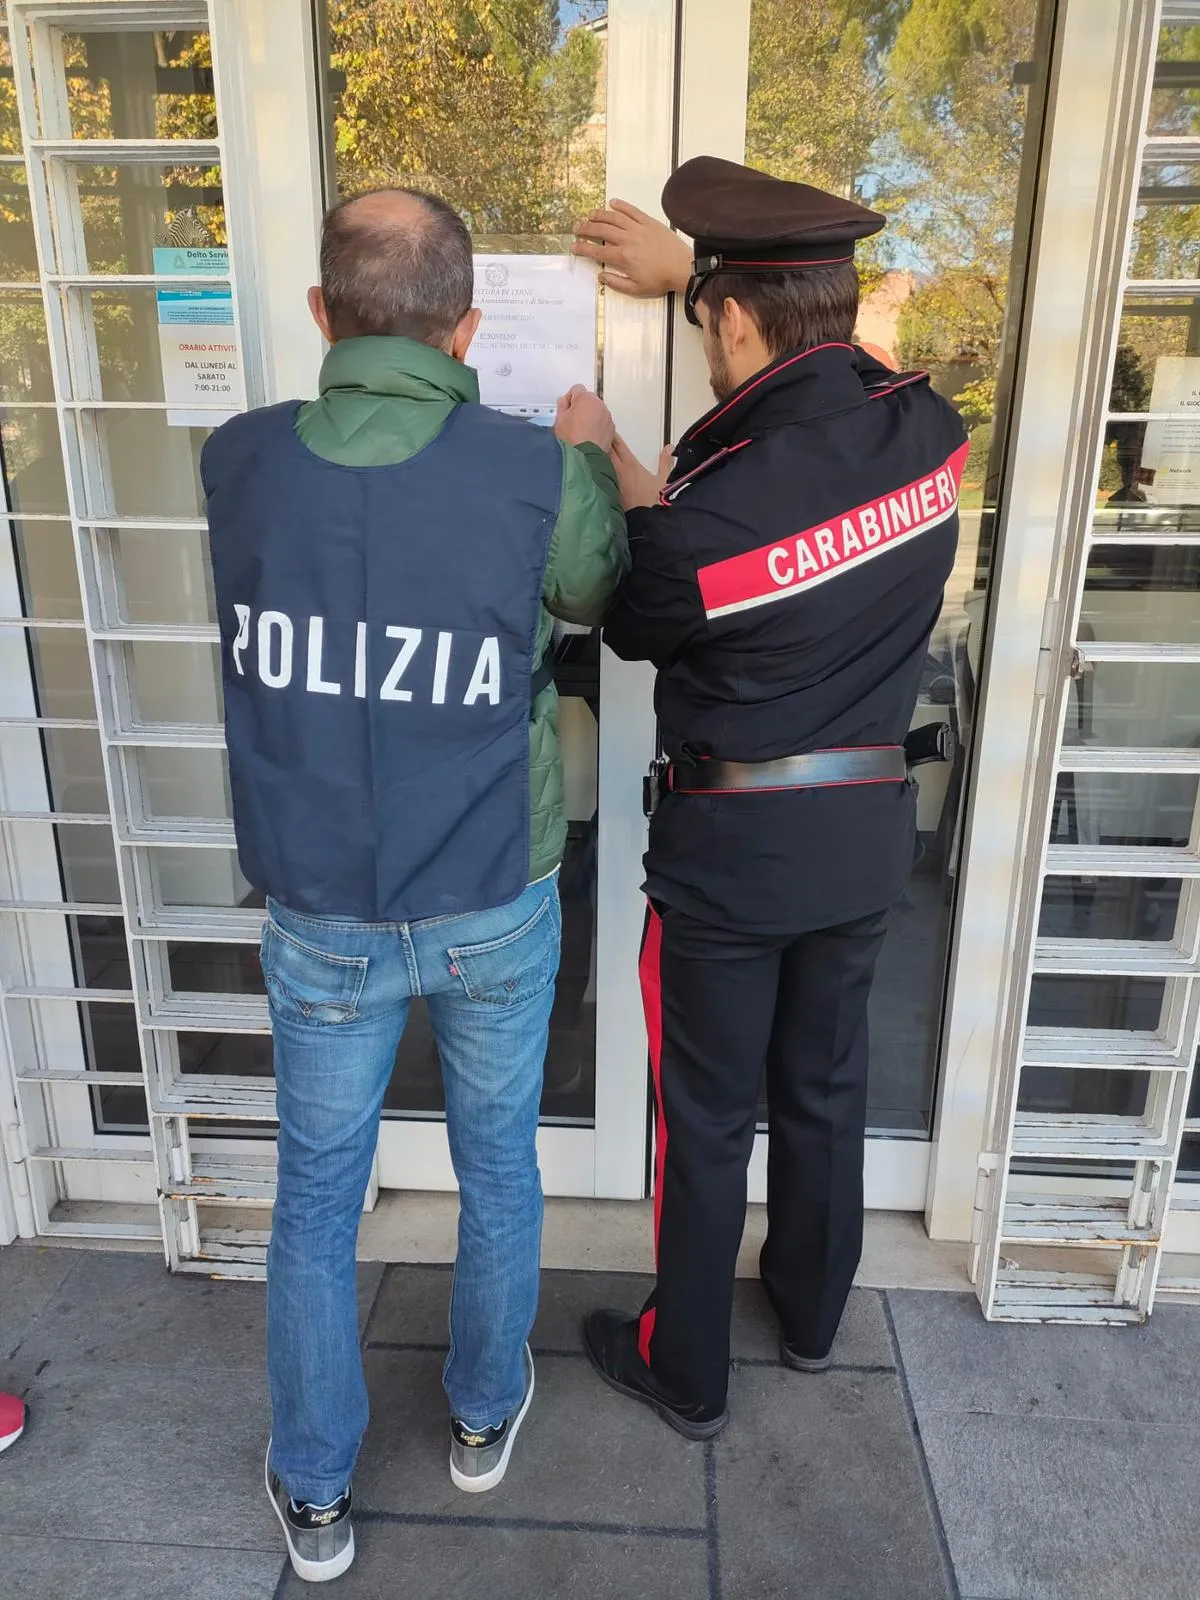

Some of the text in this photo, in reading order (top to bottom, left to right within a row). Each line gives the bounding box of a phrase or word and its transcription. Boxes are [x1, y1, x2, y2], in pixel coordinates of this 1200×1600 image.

[187, 250, 207, 258] Delta
[179, 343, 206, 351] ORARIO
[185, 361, 236, 370] DAL LUNEDÌ AL
[197, 373, 226, 381] SABATO
[194, 384, 231, 392] 7:00-21:00
[767, 465, 957, 586] CARABINIERI
[233, 604, 501, 706] POLIZIA
